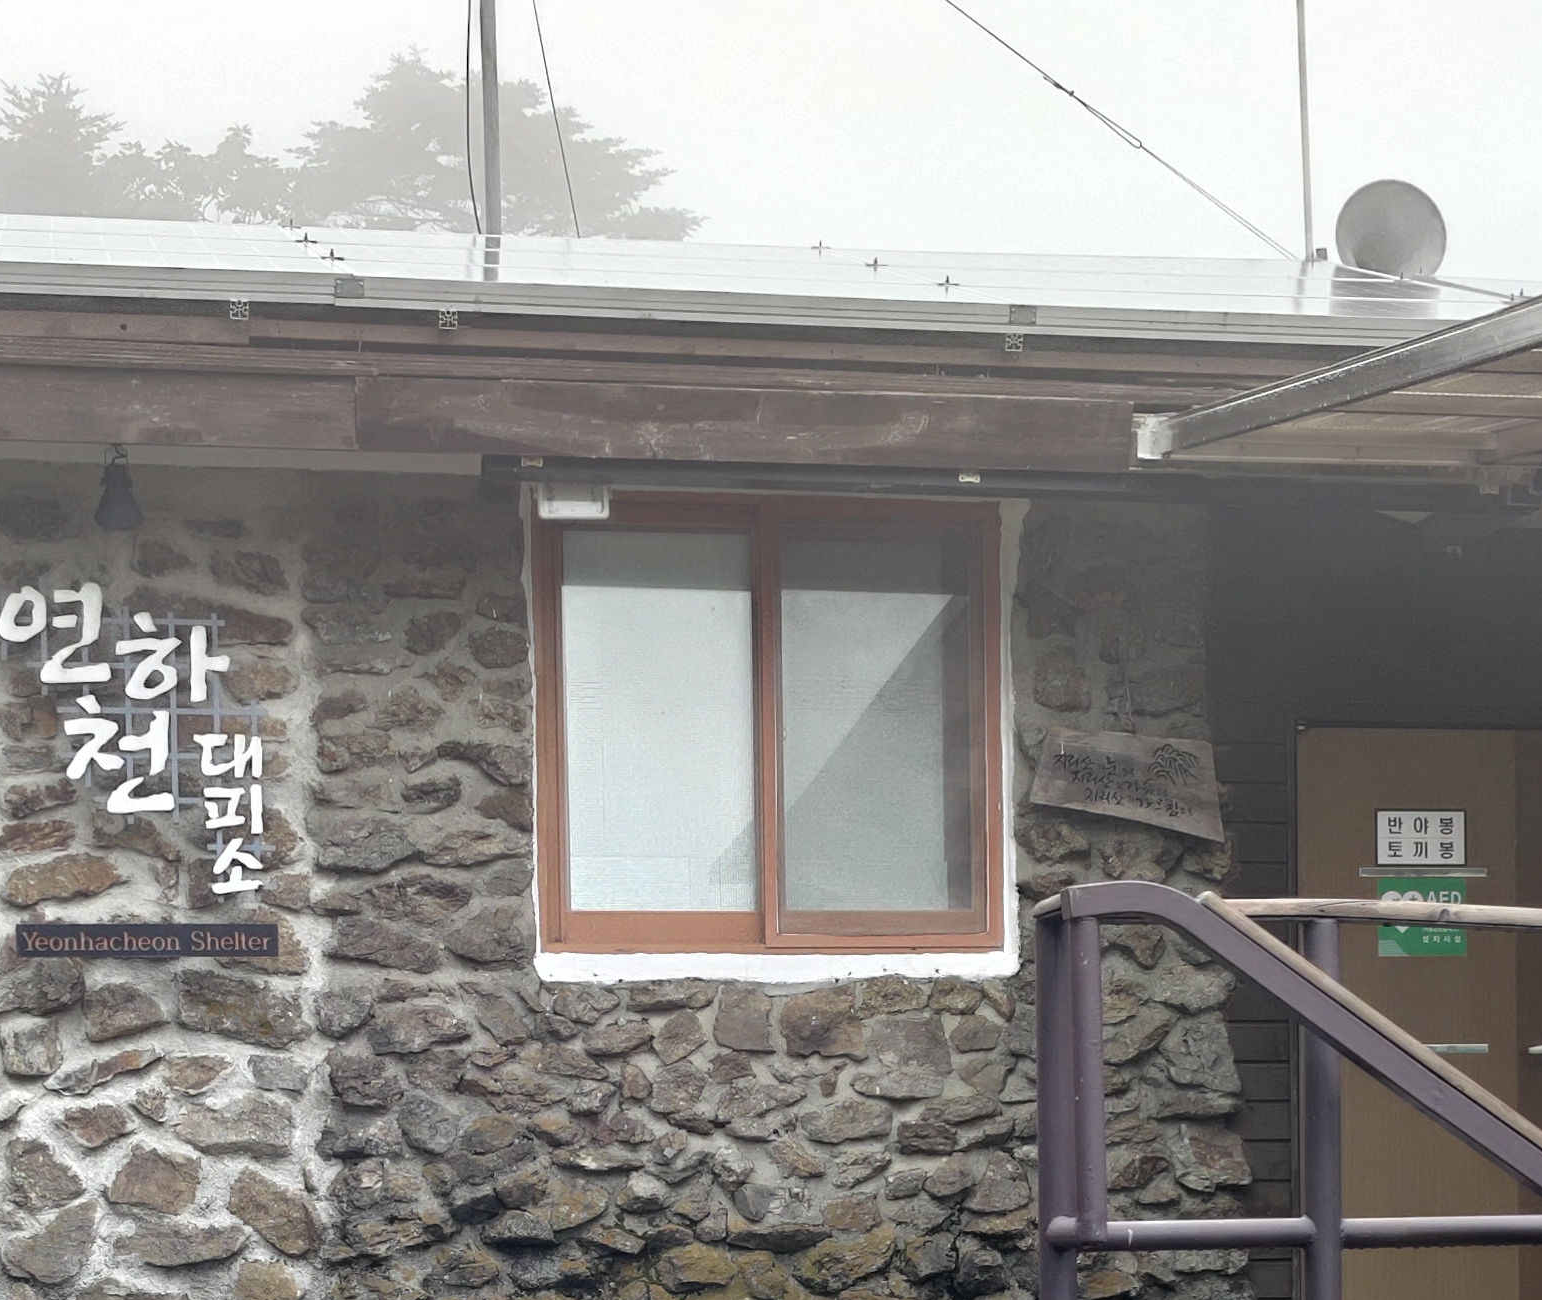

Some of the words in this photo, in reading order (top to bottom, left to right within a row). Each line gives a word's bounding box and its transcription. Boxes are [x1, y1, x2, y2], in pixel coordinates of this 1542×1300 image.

[193, 732, 263, 896] 대피소
[1387, 817, 1455, 835] 반야봉
[1387, 841, 1455, 859] 토끼봉
[22, 930, 180, 953] Yeonhacheon
[190, 930, 271, 953] Shelter
